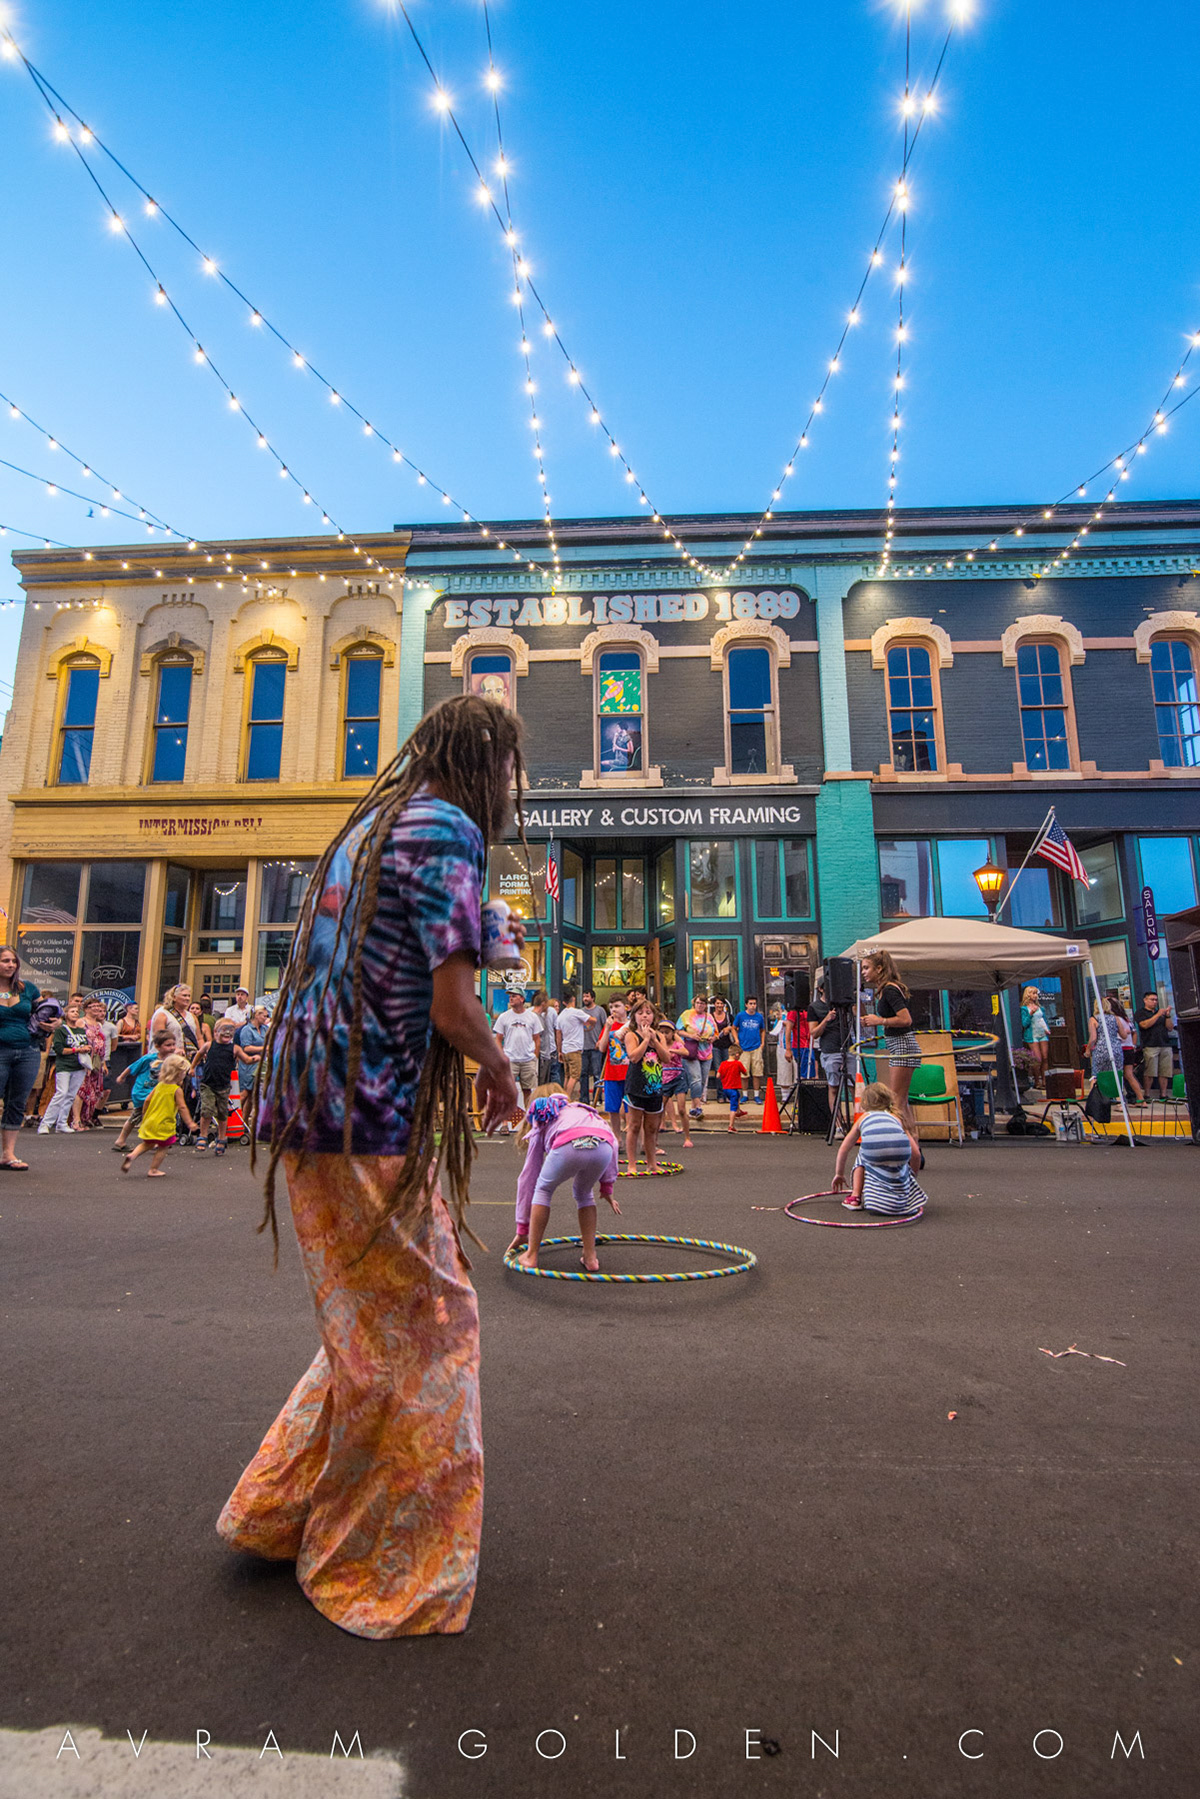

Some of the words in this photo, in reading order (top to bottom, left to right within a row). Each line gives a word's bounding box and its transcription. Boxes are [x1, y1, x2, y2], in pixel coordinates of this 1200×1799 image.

[443, 593, 710, 628] ESTABLISHED
[714, 591, 801, 622] 1889
[600, 808, 614, 826] &
[620, 807, 702, 825] CUSTOM
[709, 806, 801, 824] FRAMING
[499, 873, 530, 881] LARG
[1143, 890, 1156, 937] SALON
[22, 939, 31, 947] Bay
[29, 956, 62, 965] 893-5010
[92, 968, 126, 980] OPEN
